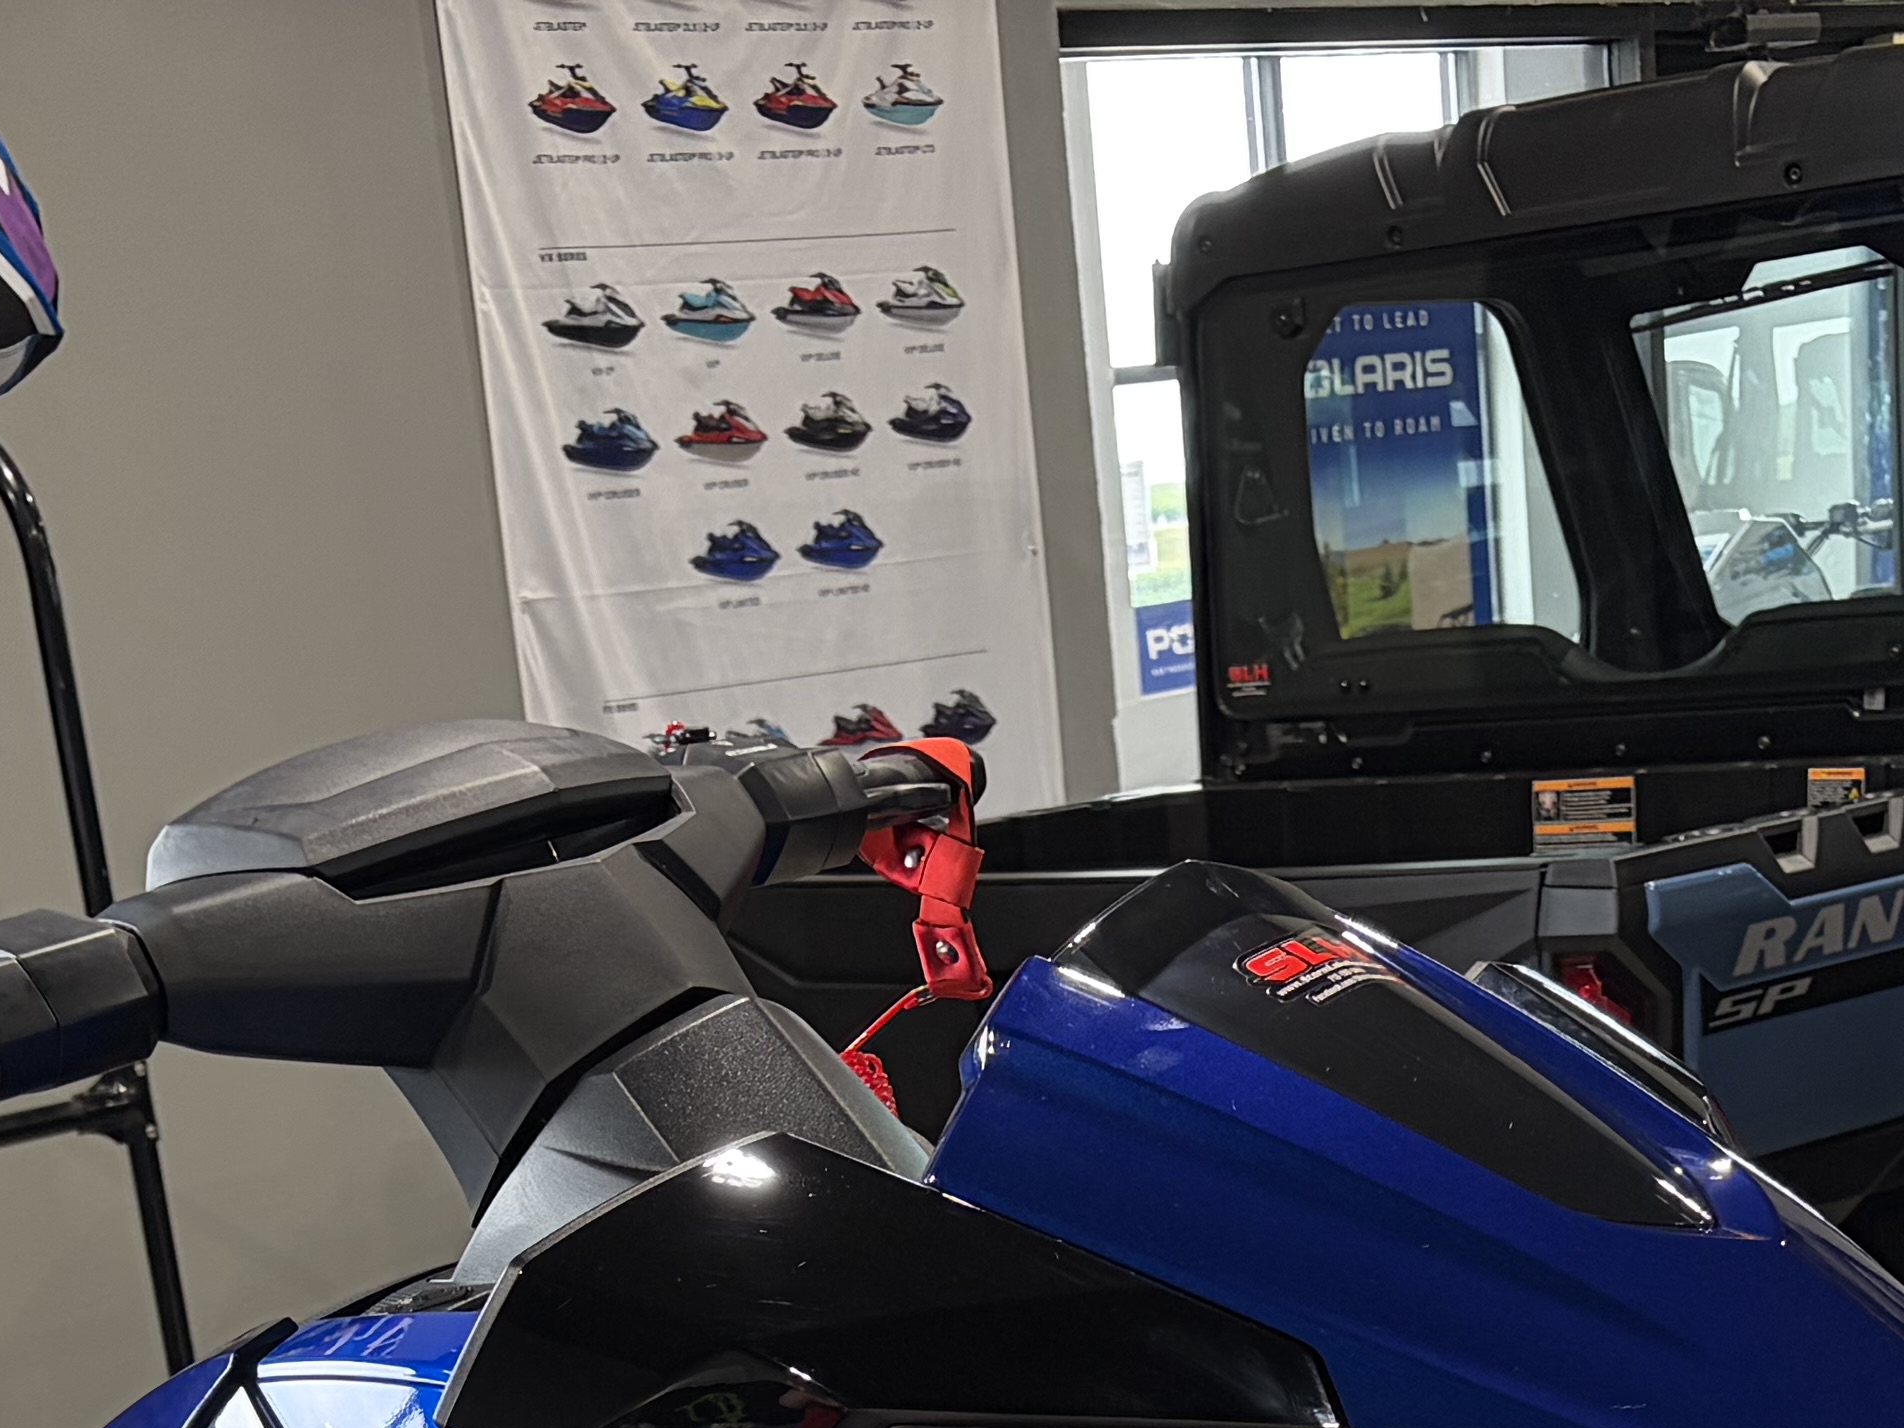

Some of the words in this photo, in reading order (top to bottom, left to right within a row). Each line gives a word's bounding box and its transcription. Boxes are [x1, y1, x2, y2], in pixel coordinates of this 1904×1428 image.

[1352, 313, 1374, 332] TO
[1382, 309, 1430, 330] LEAD
[1363, 419, 1386, 439] TO
[1394, 415, 1442, 436] ROAM
[1708, 976, 1814, 1028] SP
